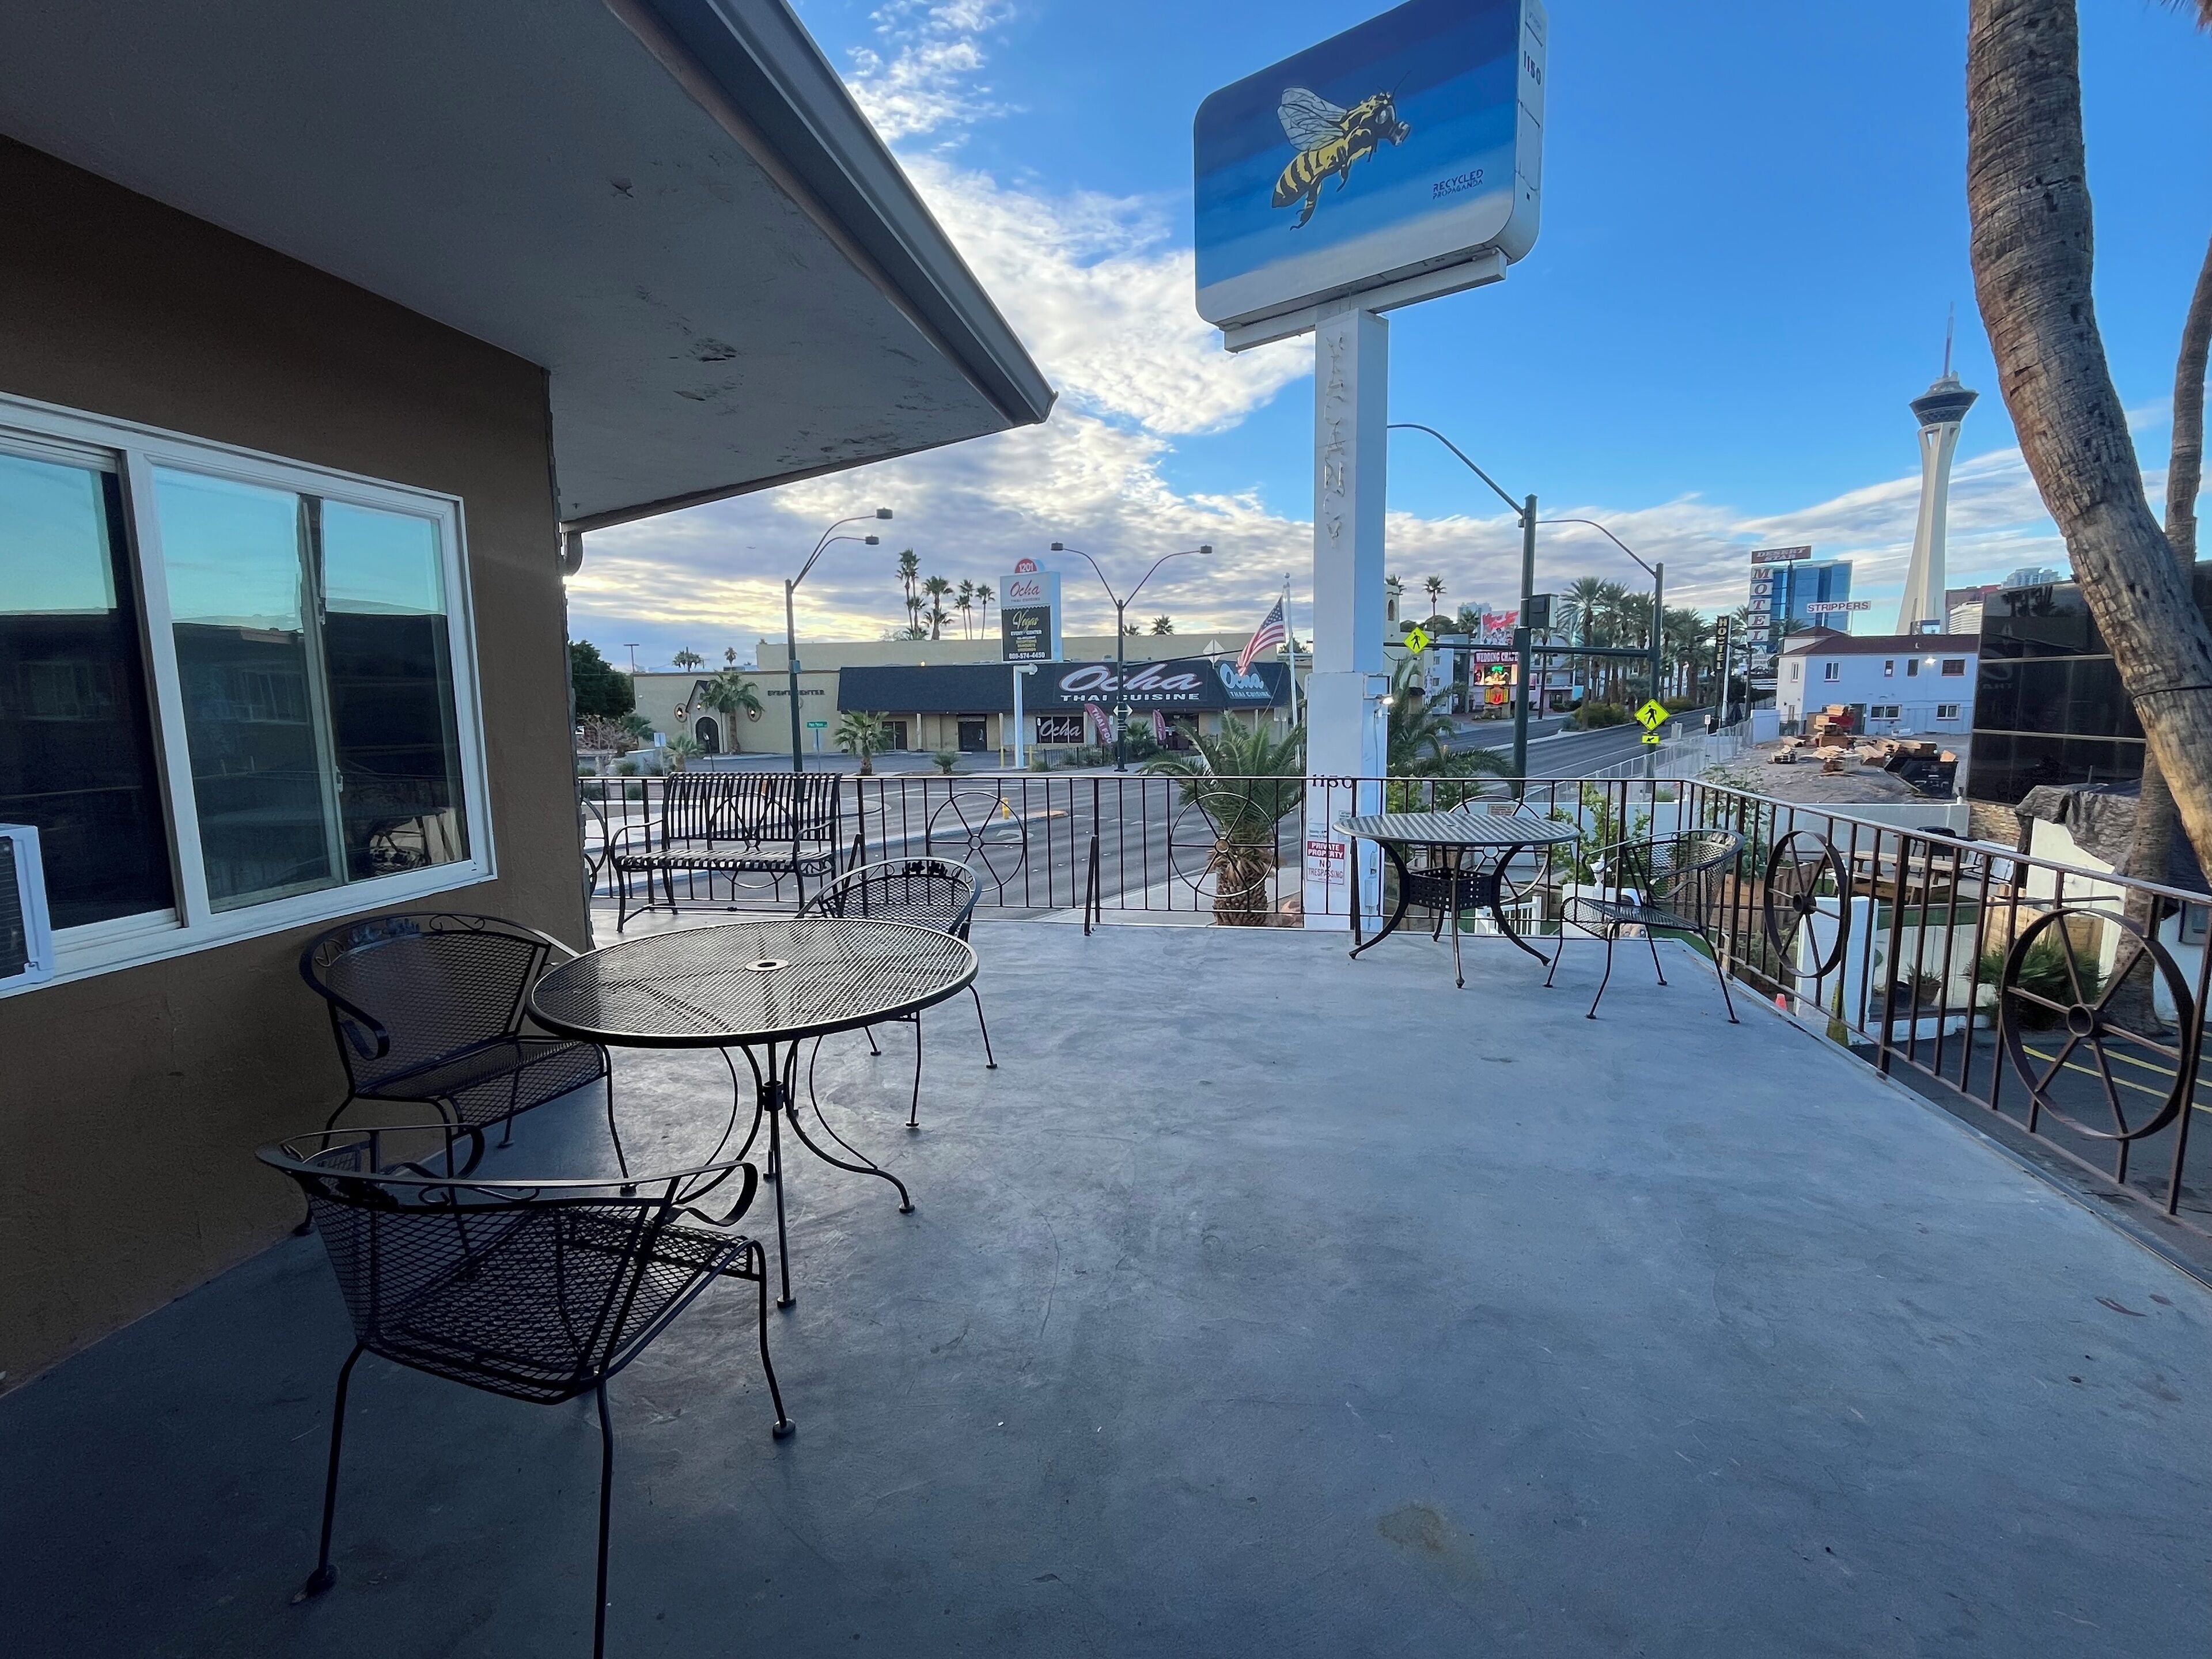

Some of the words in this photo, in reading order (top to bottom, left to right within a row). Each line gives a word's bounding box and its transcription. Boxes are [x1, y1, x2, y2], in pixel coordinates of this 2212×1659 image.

[1524, 50, 1541, 85] 1150
[1433, 169, 1483, 192] RECYCLED
[1433, 179, 1483, 199] PROPAGANDA
[1019, 563, 1034, 572] 1201
[1010, 579, 1040, 597] Ocha
[1751, 568, 1771, 641] MOTEL
[1808, 601, 1869, 612] STRIPPERS
[1012, 609, 1039, 634] Vegas
[1716, 619, 1728, 670] HOSTEL
[1476, 652, 1500, 662] WEDDING
[1059, 663, 1203, 692] Ocha
[1116, 693, 1199, 701] CUISINE
[1040, 719, 1081, 737] Ocha
[1092, 708, 1105, 727] THAI
[1101, 728, 1112, 745] FOO
[1312, 774, 1353, 789] 1150
[1319, 859, 1331, 868] NO
[1308, 868, 1343, 879] TRESPASSING
